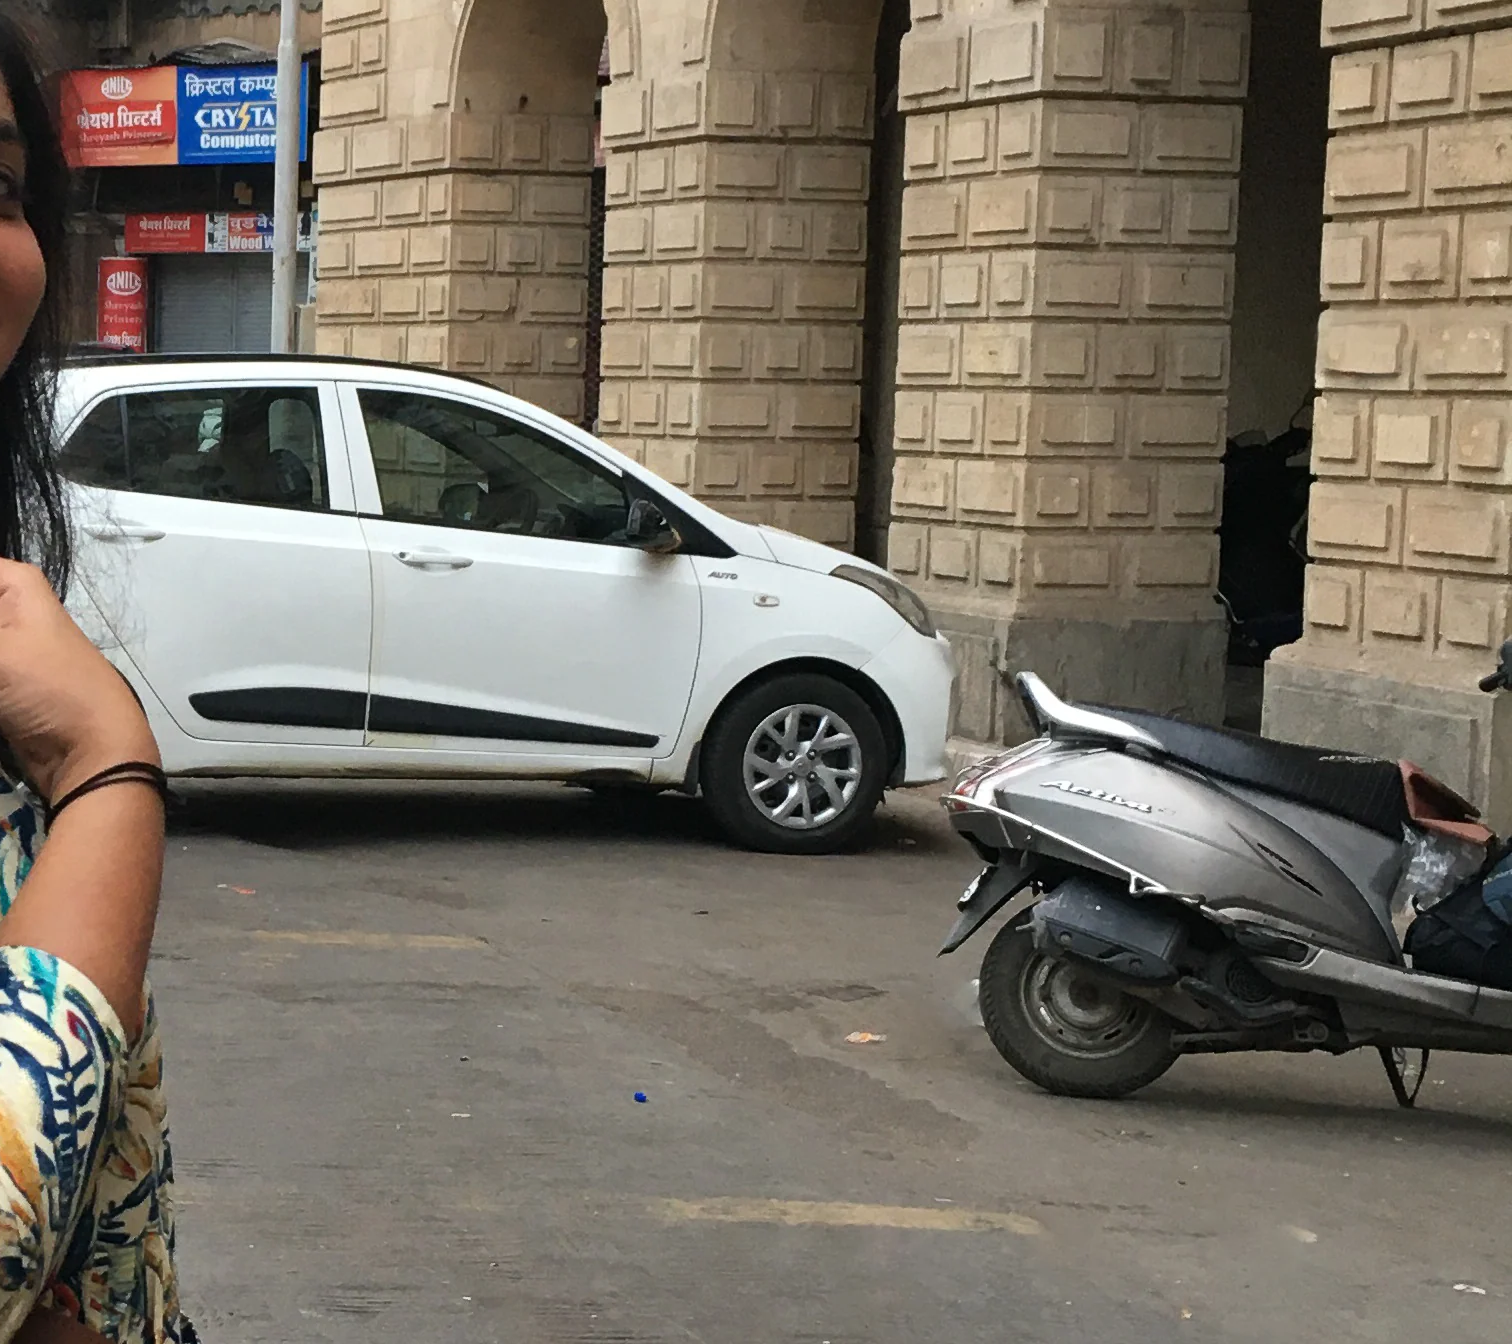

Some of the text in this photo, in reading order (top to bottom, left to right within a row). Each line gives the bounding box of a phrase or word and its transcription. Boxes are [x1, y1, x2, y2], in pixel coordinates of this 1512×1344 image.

[184, 73, 235, 97] क्रिस्टल
[194, 104, 276, 131] CRYSTA
[229, 235, 263, 250] Wood
